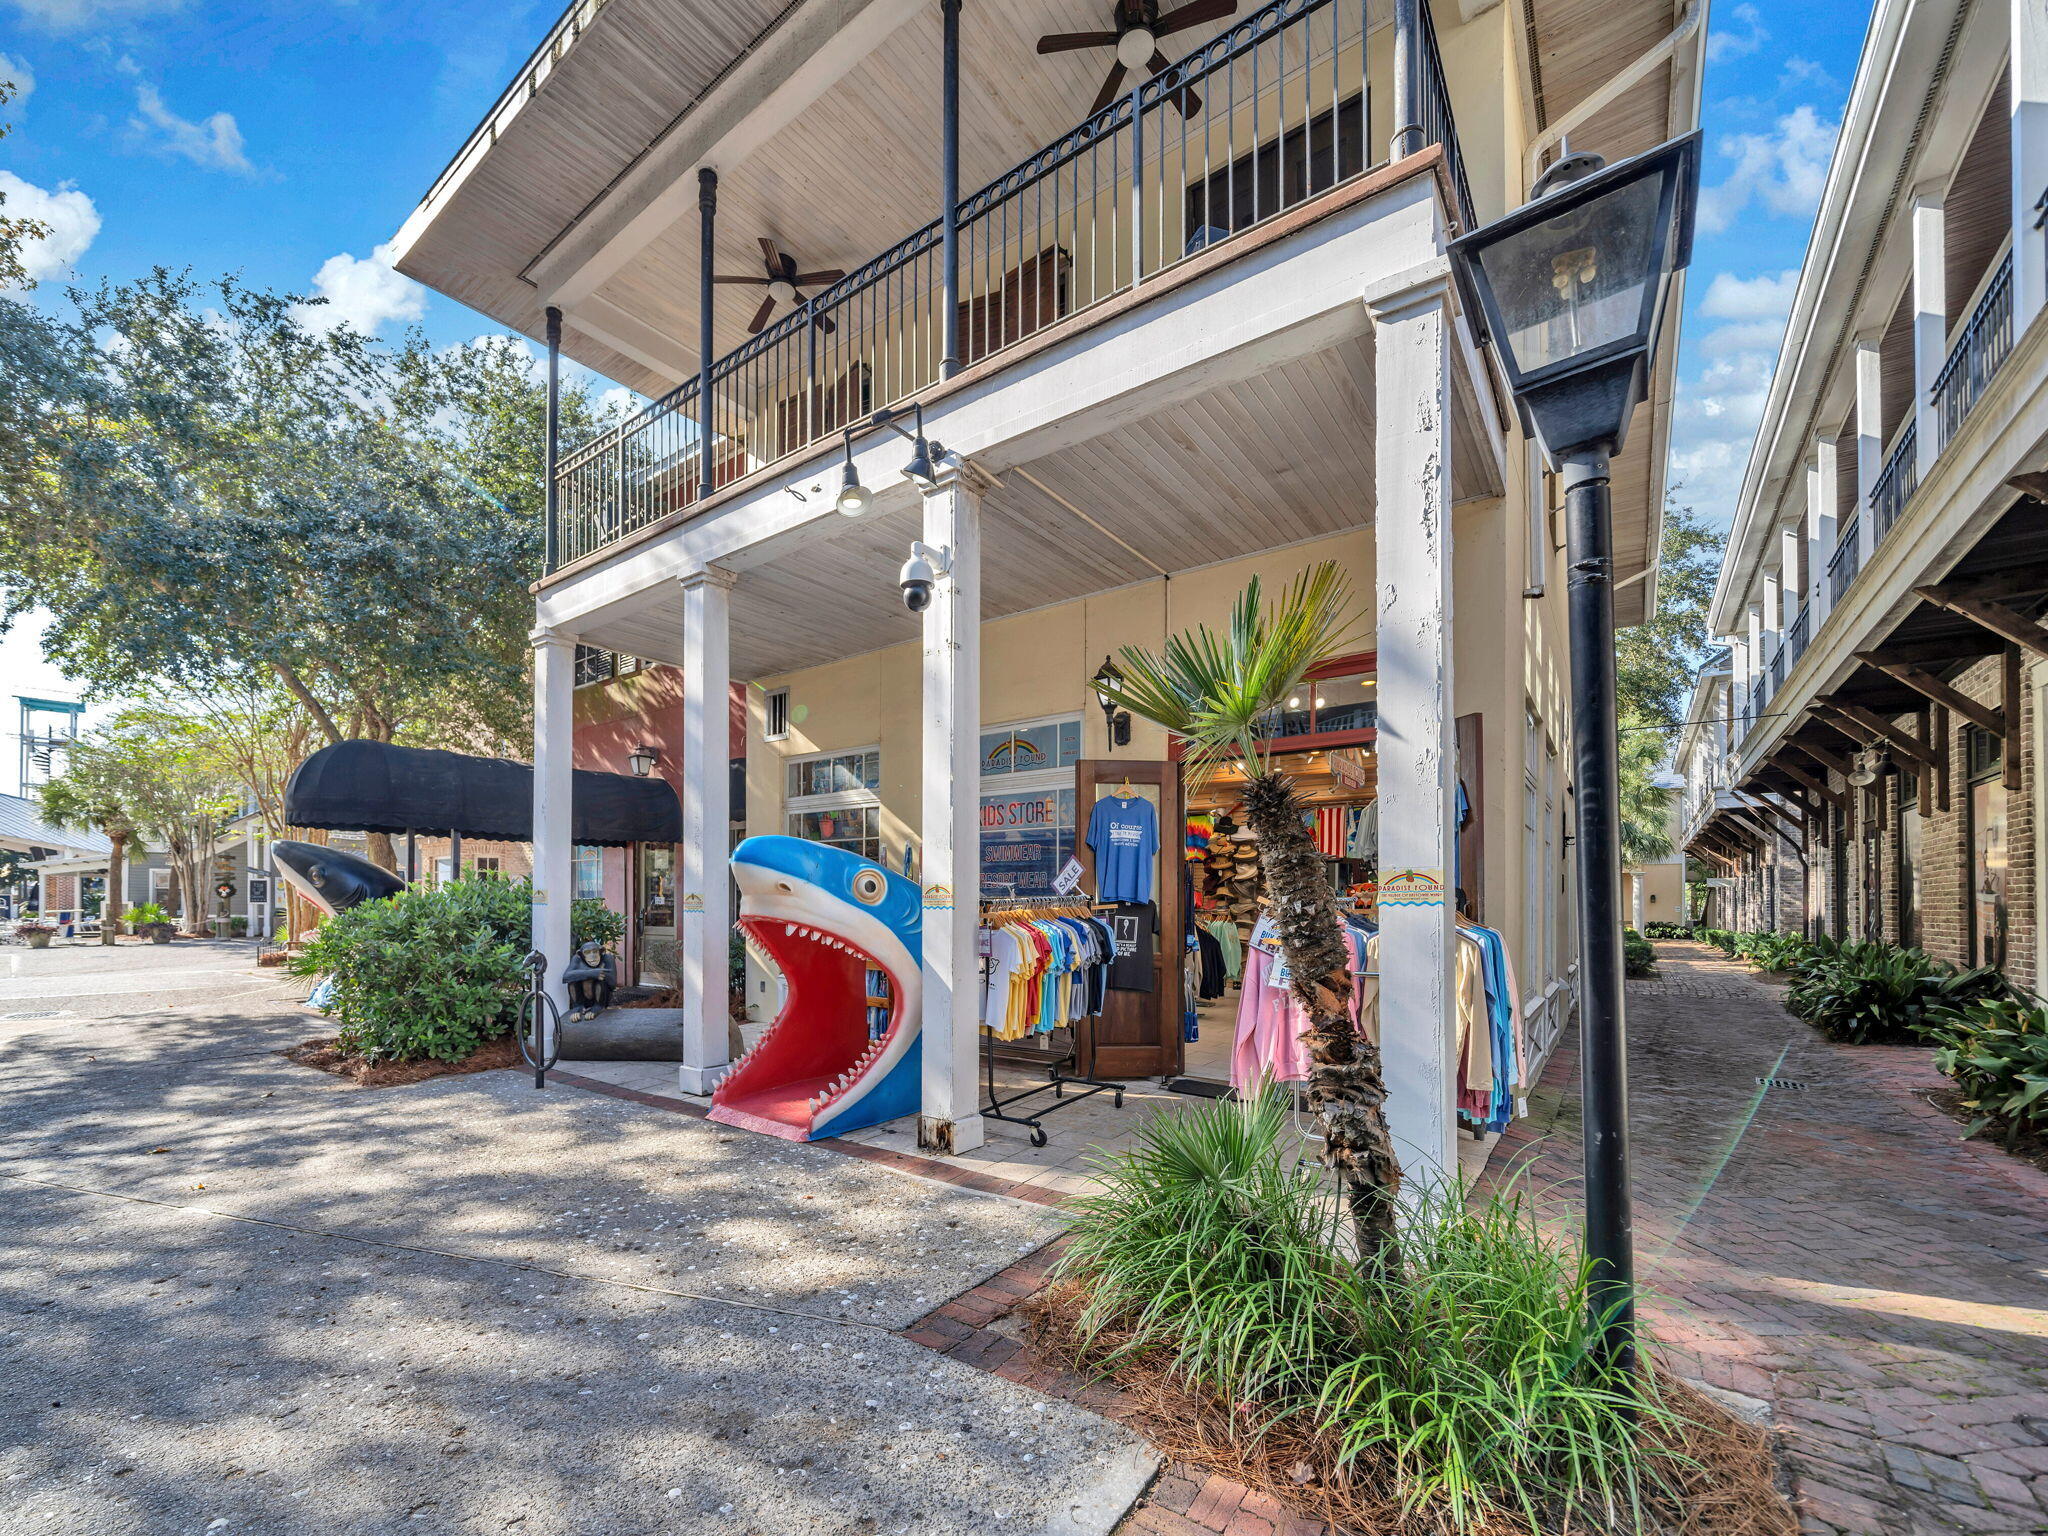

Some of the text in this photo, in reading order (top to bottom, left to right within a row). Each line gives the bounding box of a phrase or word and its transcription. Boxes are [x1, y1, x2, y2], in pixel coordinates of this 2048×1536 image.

[981, 752, 1047, 768] PARADISE FOUND
[1008, 800, 1054, 825] STORE
[985, 844, 1041, 862] SWIMWEAR
[980, 872, 1048, 889] RESORT WEAR
[1058, 865, 1080, 891] SALE
